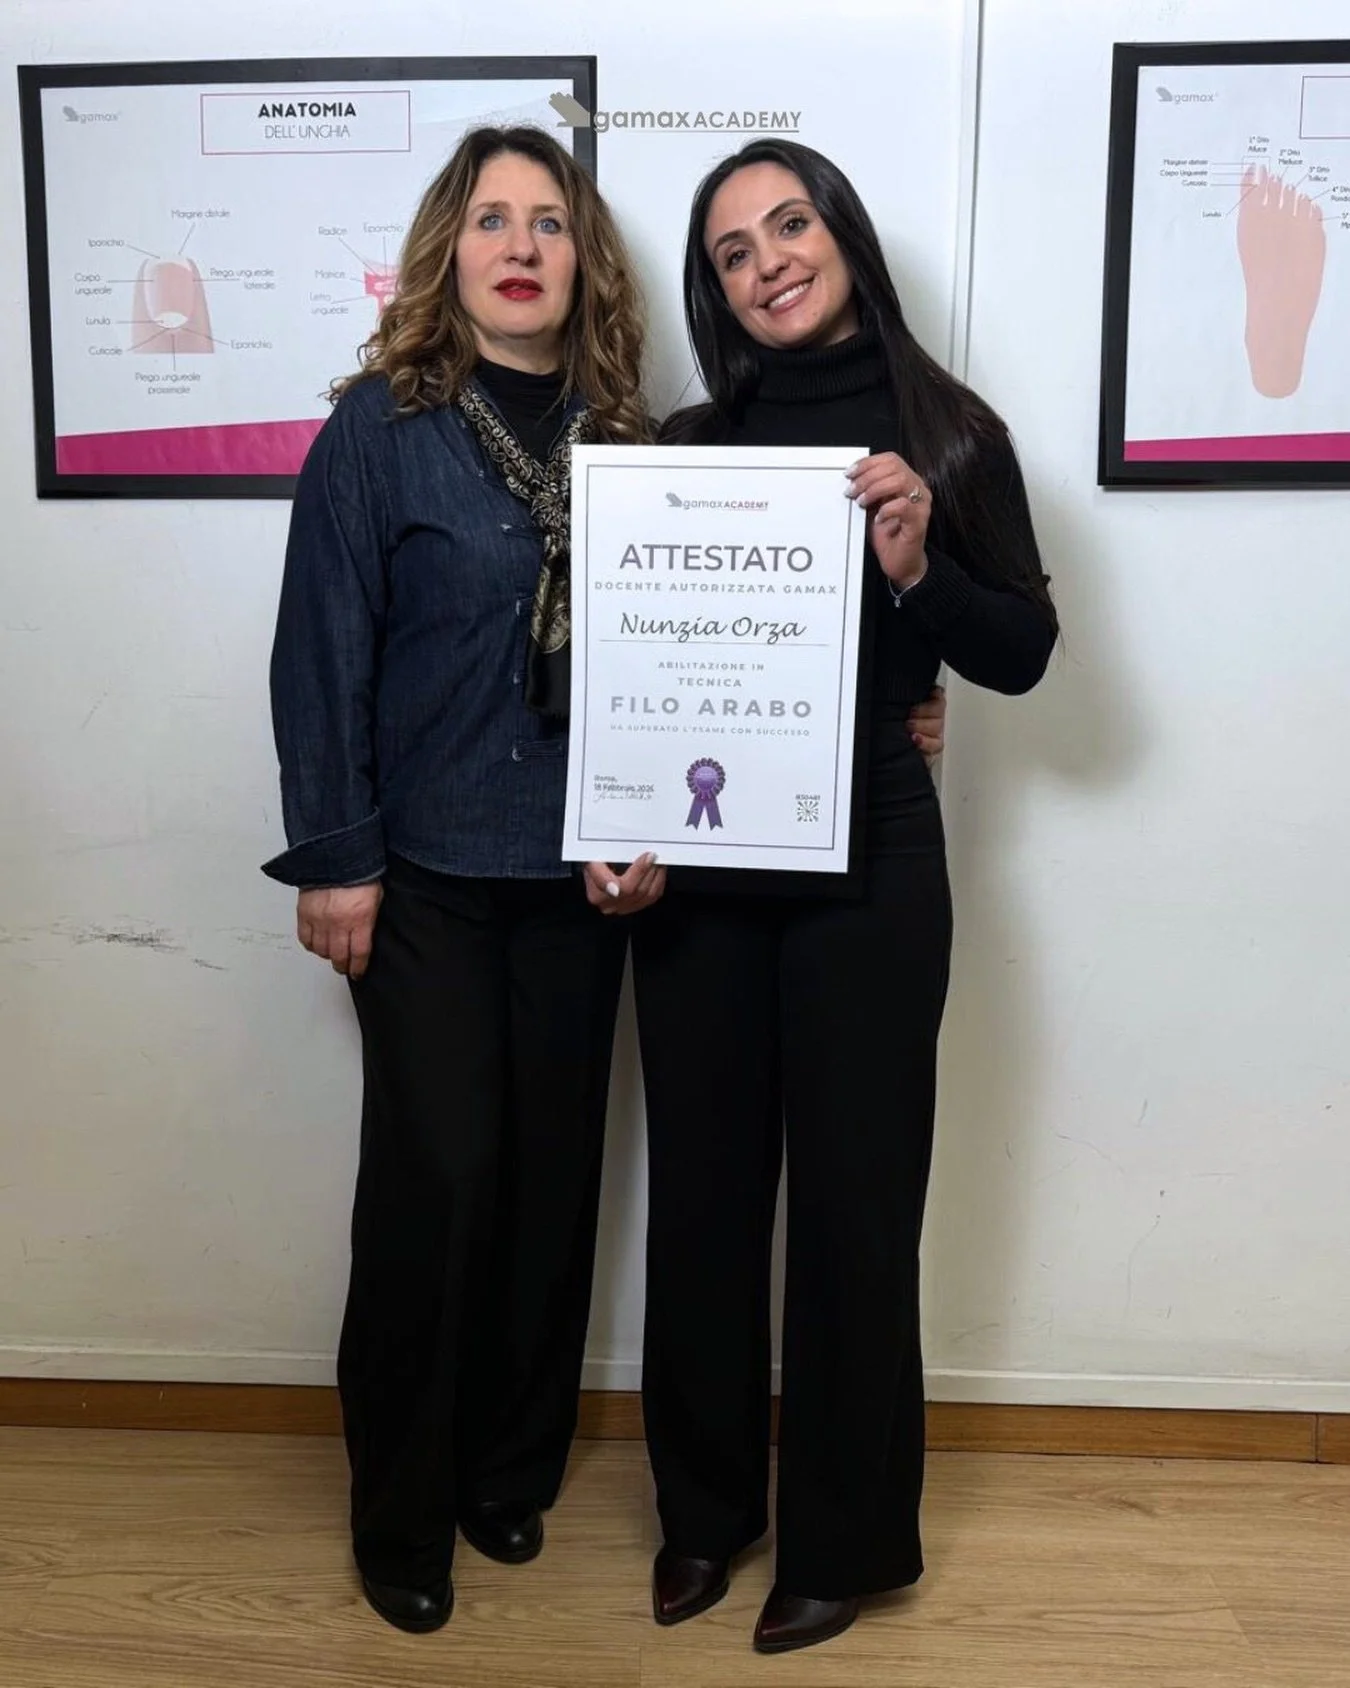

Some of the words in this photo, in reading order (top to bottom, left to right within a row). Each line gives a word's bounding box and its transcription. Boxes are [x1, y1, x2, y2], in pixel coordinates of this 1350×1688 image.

[1174, 93, 1214, 104] gamax
[258, 102, 357, 118] ANATOMIA
[80, 112, 119, 124] gamax
[74, 272, 101, 282] Corpo
[619, 543, 814, 573] ATTESTATO
[594, 581, 662, 592] DOCENTE
[669, 582, 776, 594] AUTORIZZATA
[783, 584, 837, 594] GAMAX
[620, 611, 728, 643] Nunzia
[731, 616, 807, 645] Orza
[658, 661, 746, 671] ABILITAZIONE
[751, 663, 765, 671] IN
[677, 677, 743, 688] TECNICA
[610, 696, 680, 715] FILO
[698, 698, 812, 719] ARABO
[627, 725, 679, 733] SUPERATO
[756, 729, 811, 737] SUCCESSO
